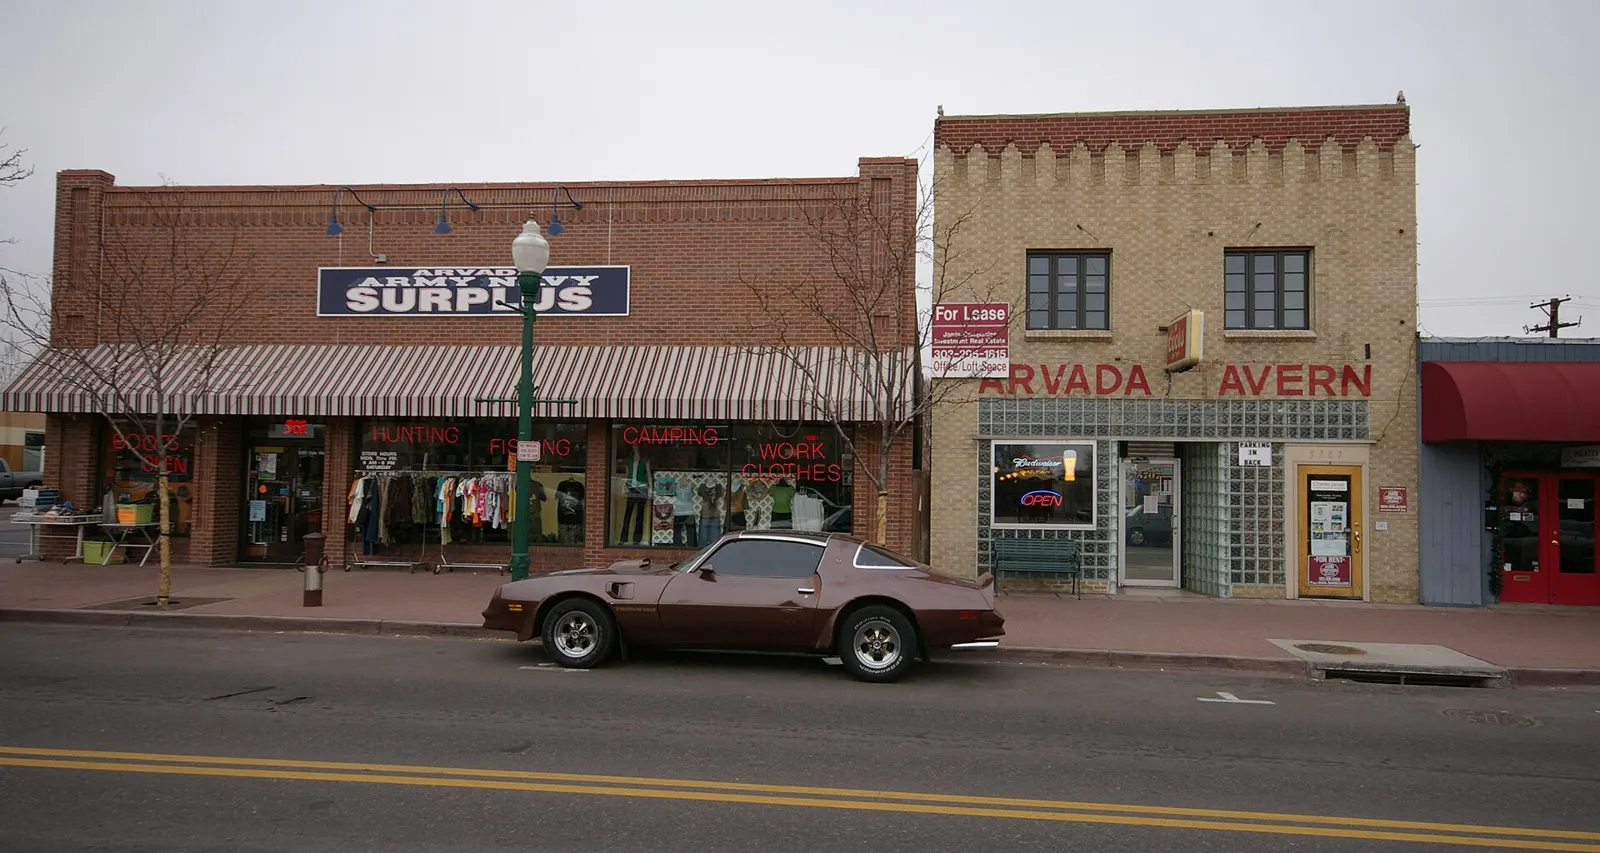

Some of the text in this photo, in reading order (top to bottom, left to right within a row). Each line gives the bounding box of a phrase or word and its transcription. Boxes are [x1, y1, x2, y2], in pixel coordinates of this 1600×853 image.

[358, 275, 599, 287] ARMY NVY
[345, 287, 593, 312] SURPLUS
[935, 306, 1006, 320] For Lease
[981, 360, 1007, 374] Space
[978, 363, 1153, 395] ARVADA
[1218, 364, 1372, 397] AVERN
[371, 425, 460, 444] HUNTING
[623, 426, 718, 446] CAMPING
[489, 438, 571, 457] FISNG
[759, 442, 826, 460] WORK
[1013, 457, 1062, 468] Budweiser
[741, 463, 841, 482] CLOTHES
[1023, 494, 1063, 507] OPEN
